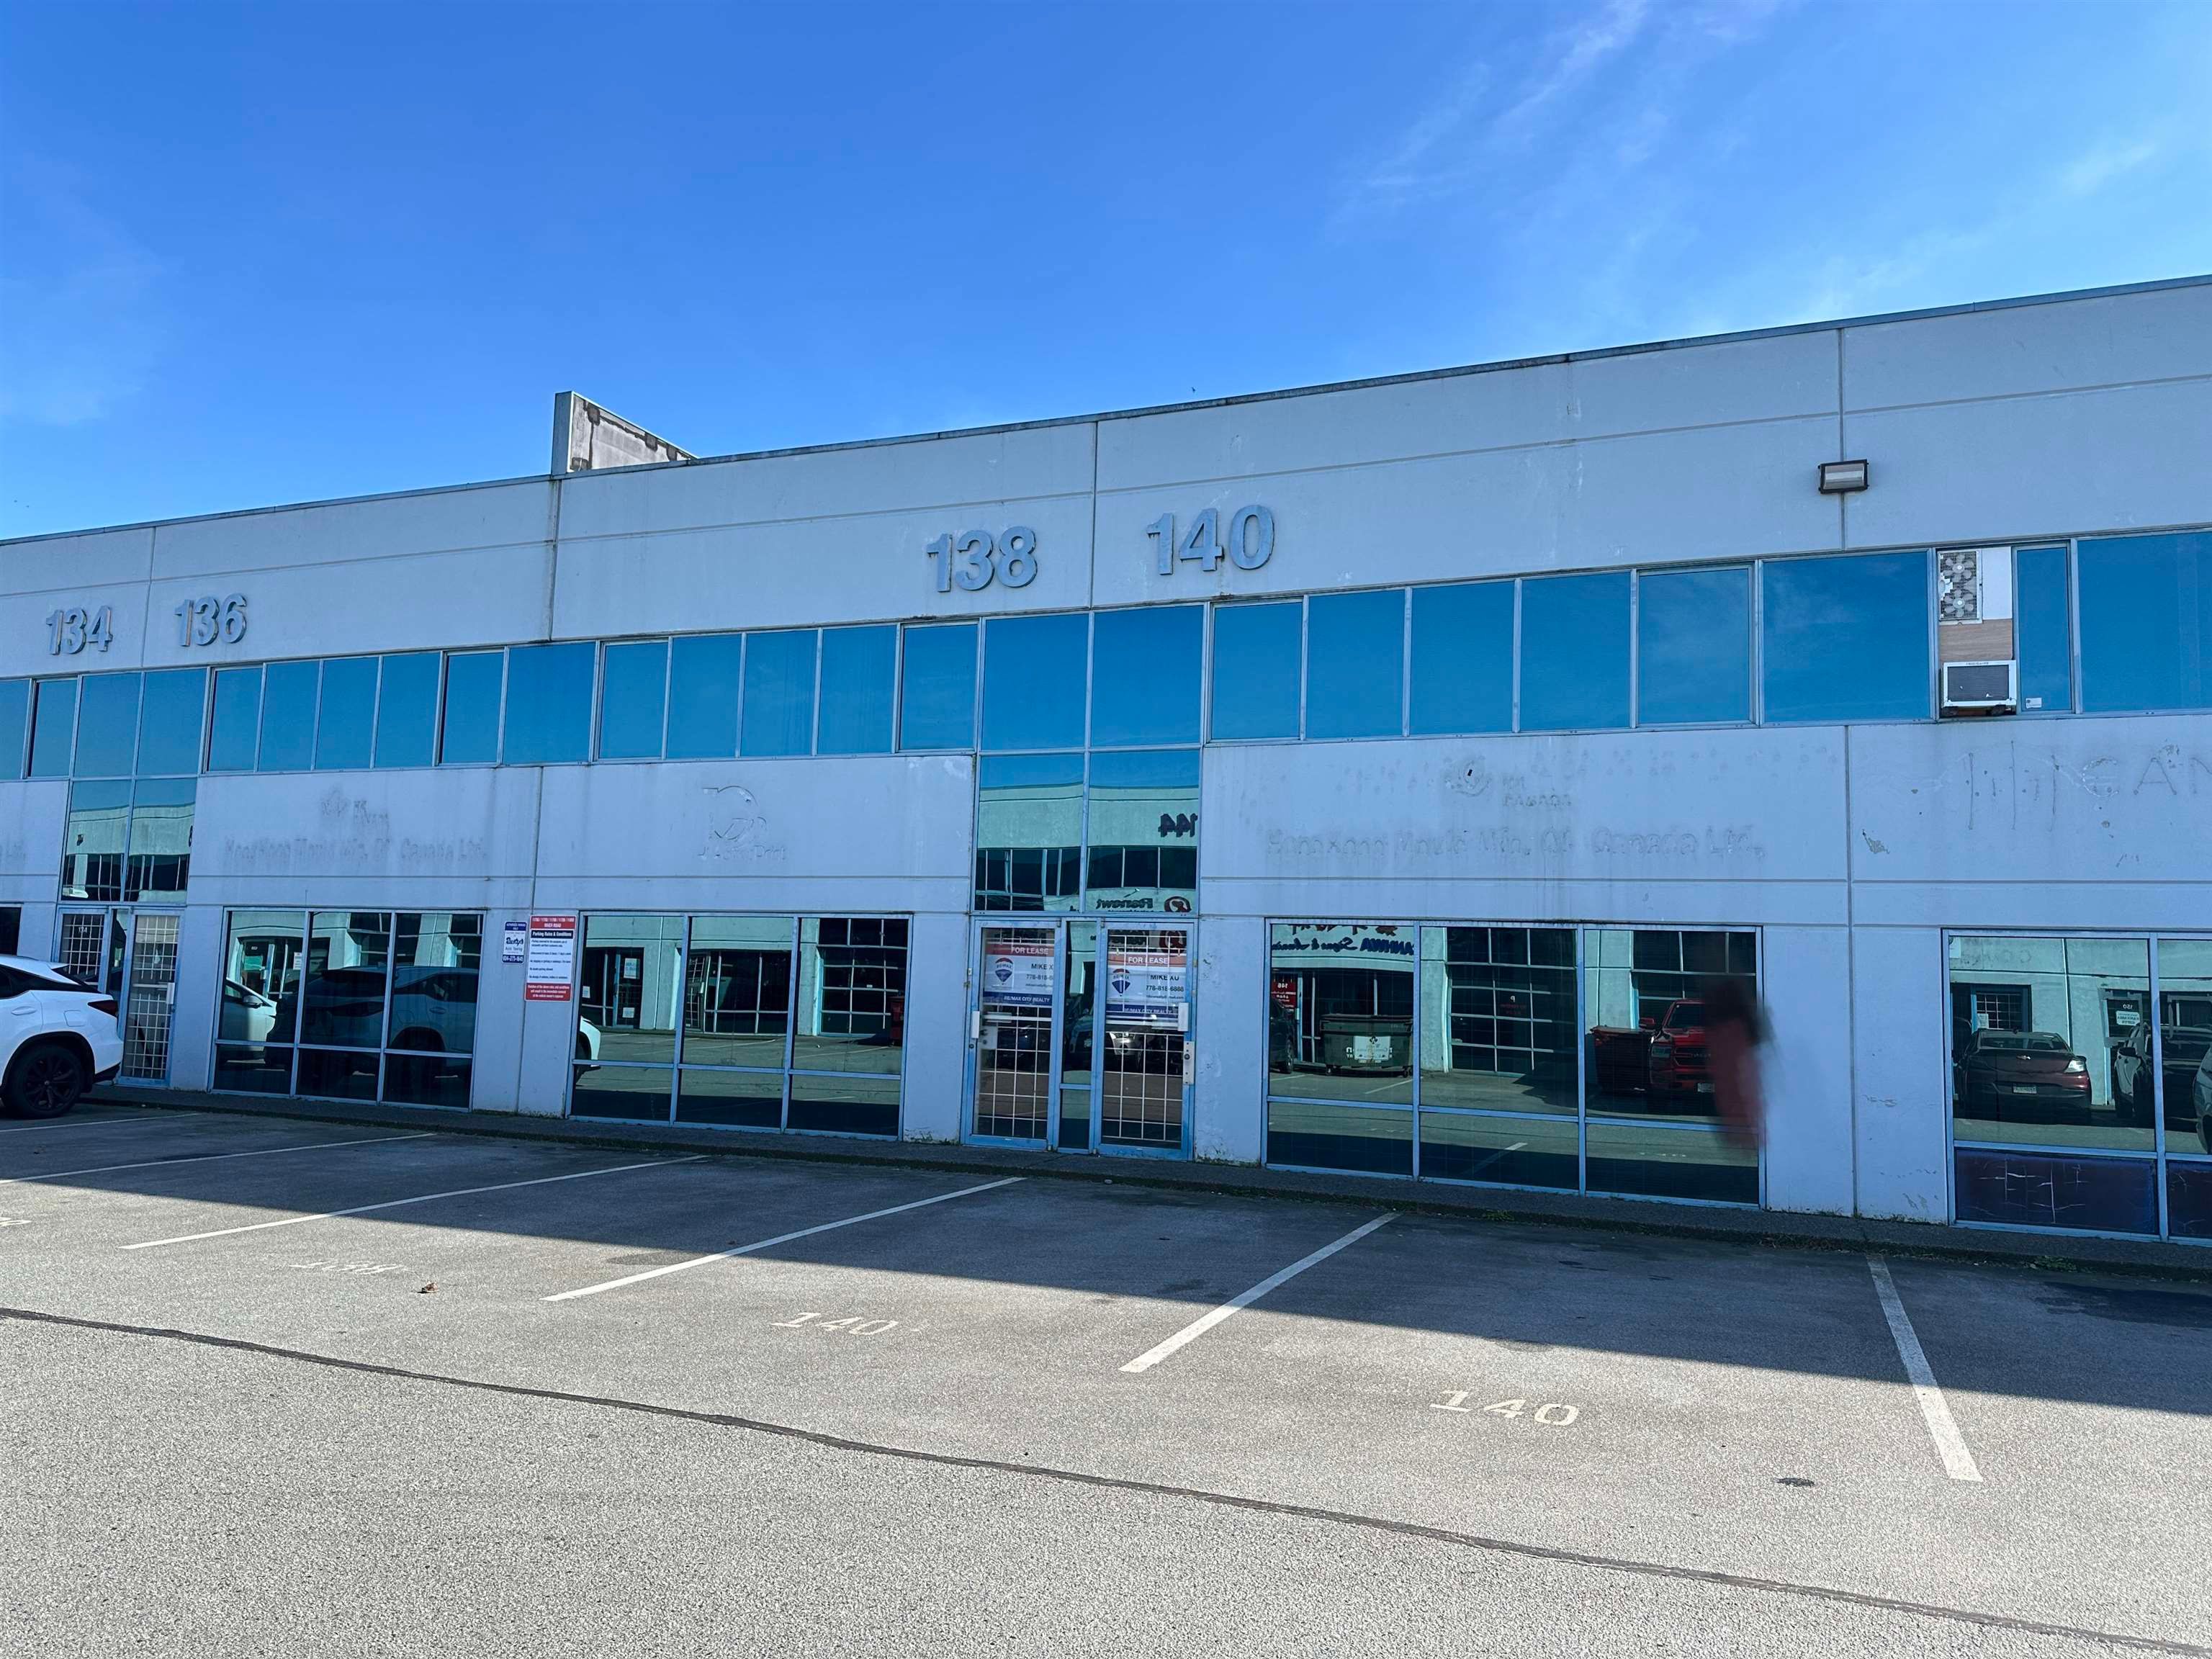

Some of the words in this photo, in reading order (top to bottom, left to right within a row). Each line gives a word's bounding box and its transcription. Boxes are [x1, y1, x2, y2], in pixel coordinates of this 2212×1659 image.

[927, 526, 1038, 593] 138
[1147, 504, 1275, 575] 140
[46, 606, 113, 655] 134
[175, 593, 247, 647] 136
[769, 1312, 899, 1335] 140
[1429, 1390, 1579, 1426] 140
